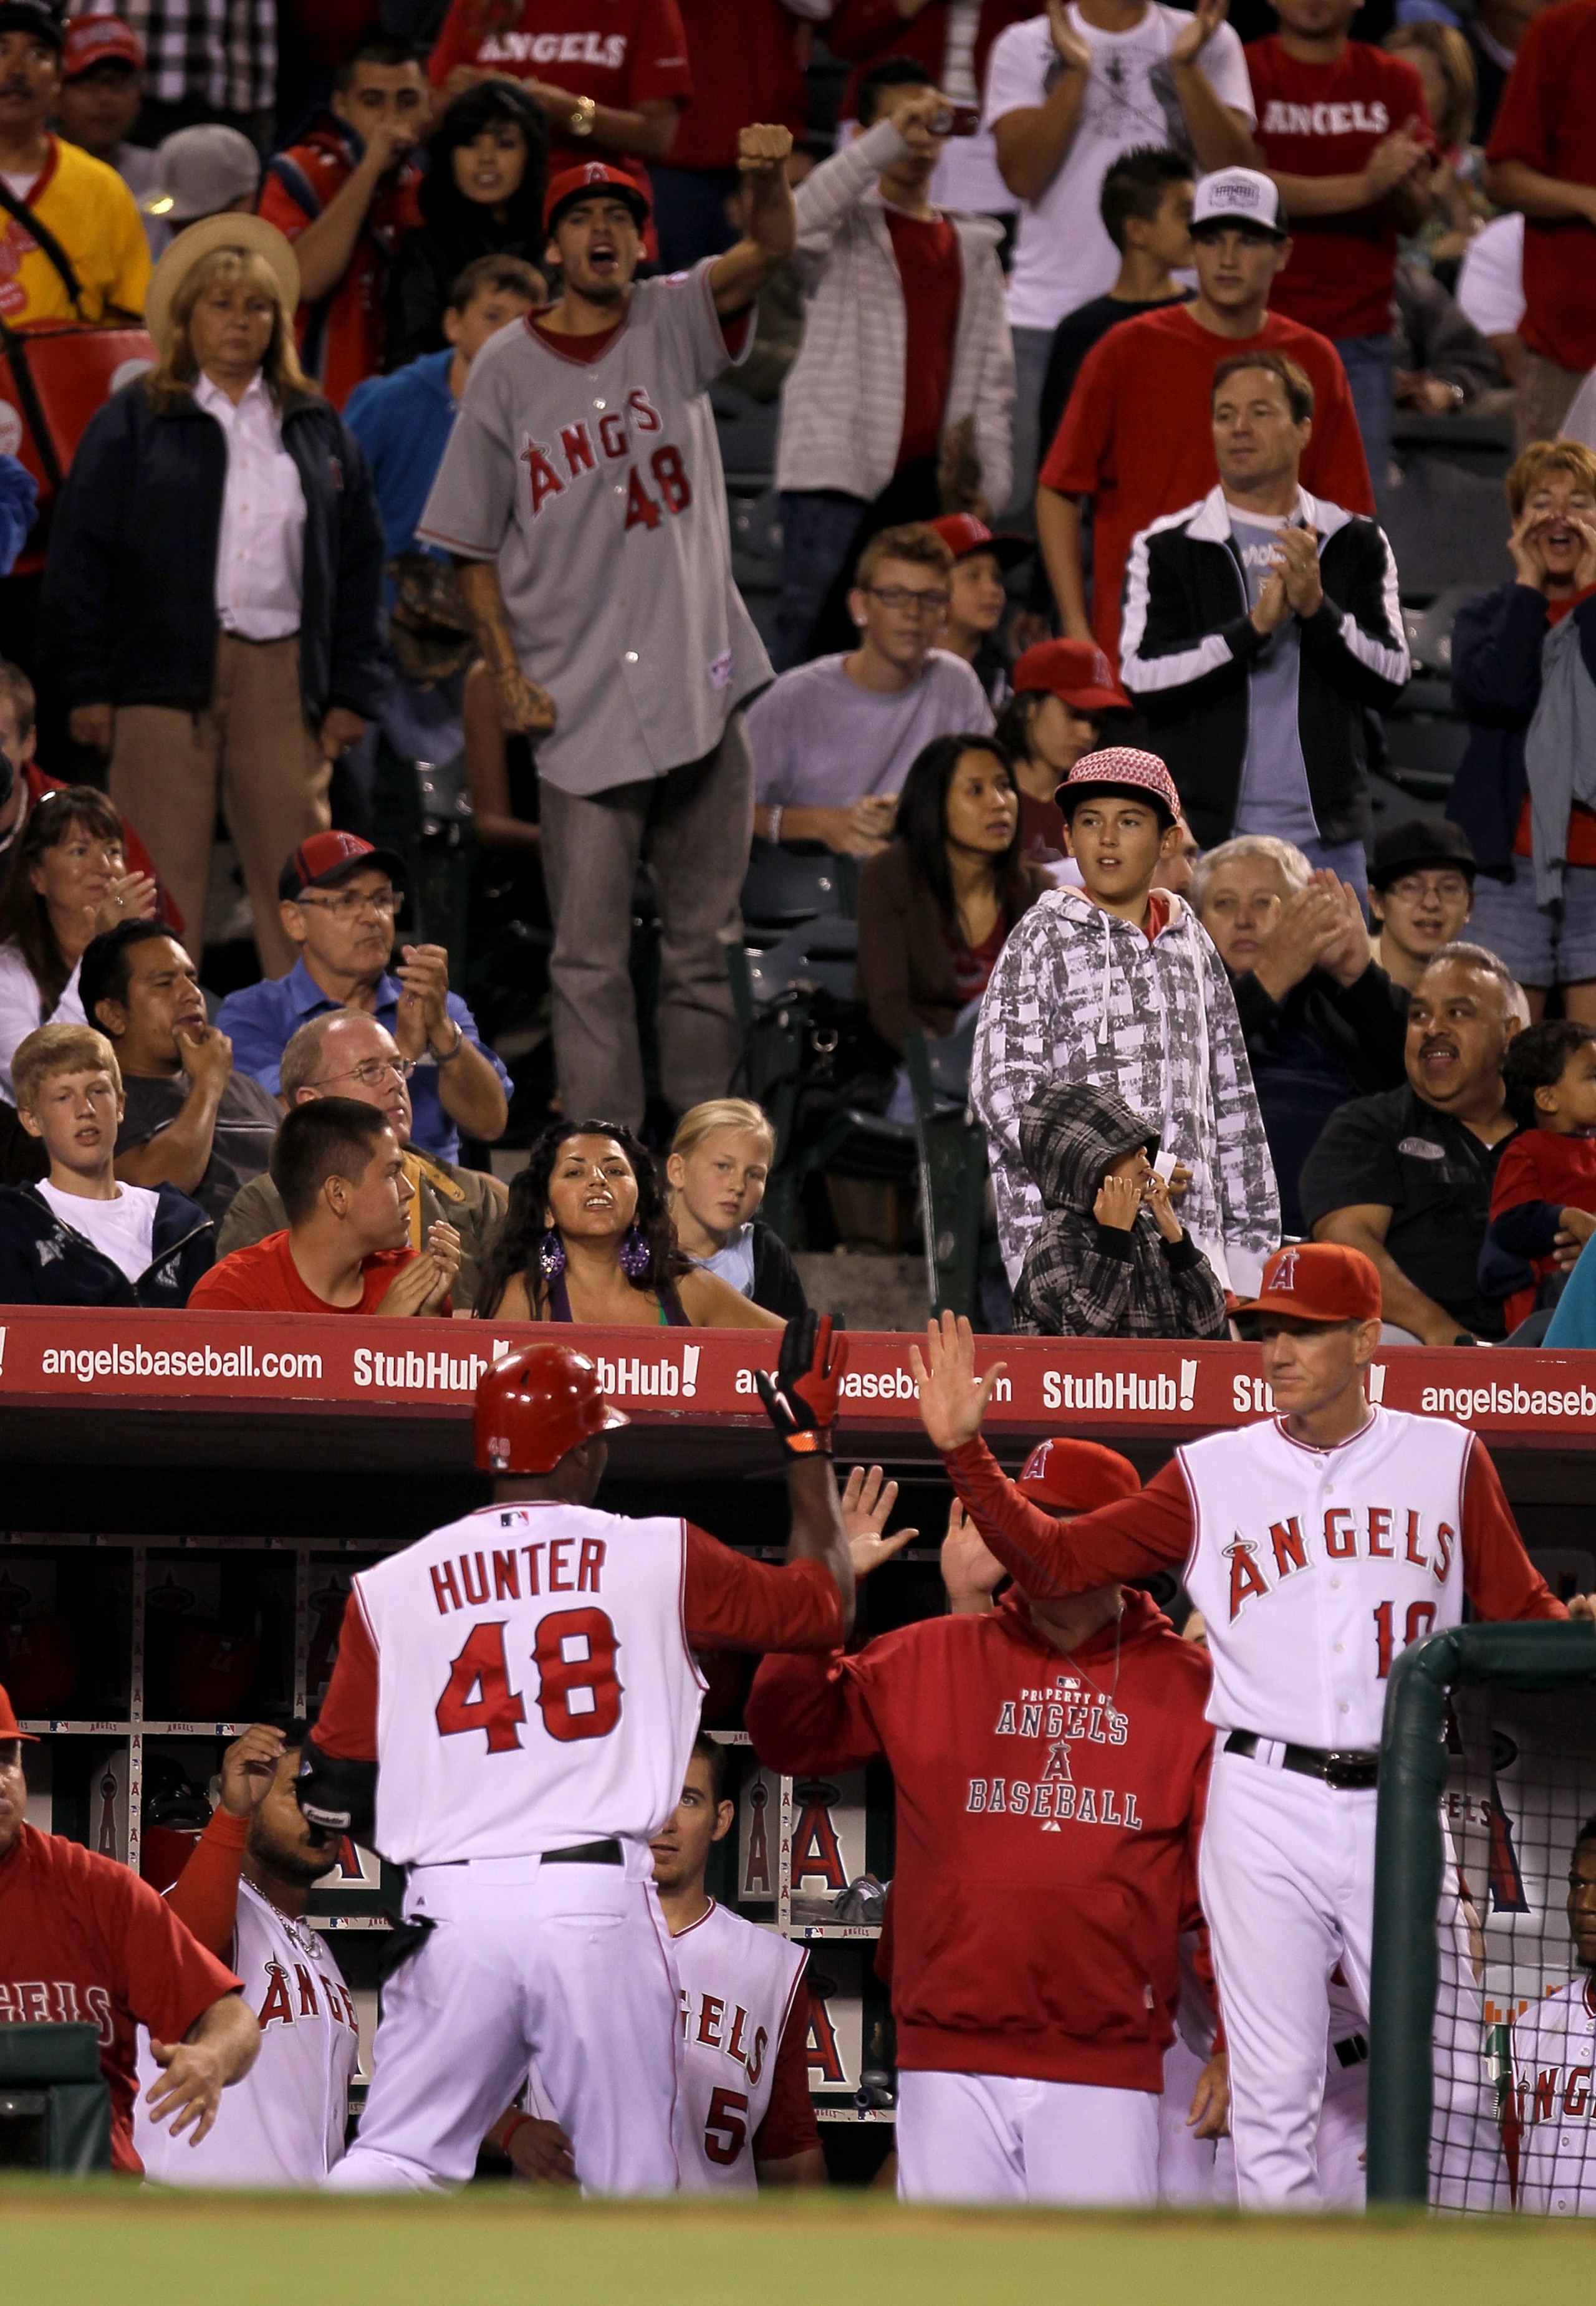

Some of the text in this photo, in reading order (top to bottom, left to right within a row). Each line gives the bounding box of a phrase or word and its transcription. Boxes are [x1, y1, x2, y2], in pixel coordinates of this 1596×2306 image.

[476, 31, 627, 69] ANGELS
[1263, 100, 1390, 137] ANGELS
[624, 444, 692, 531] 48
[42, 1343, 323, 1382] angelsbaseball.com
[1042, 1358, 1198, 1412] StubHub!
[488, 1436, 511, 1457] 48
[430, 1537, 607, 1616] HUNTER
[1221, 1506, 1456, 1626] ANGELS
[435, 1606, 626, 1755] 48
[90, 1721, 117, 1732] ANGELS
[166, 1722, 194, 1733] ANGELS
[996, 1701, 1129, 1746] ANGELS
[966, 1778, 1143, 1831] BASEBALL
[844, 1927, 870, 1937] ANGELS
[704, 2086, 749, 2166] 5
